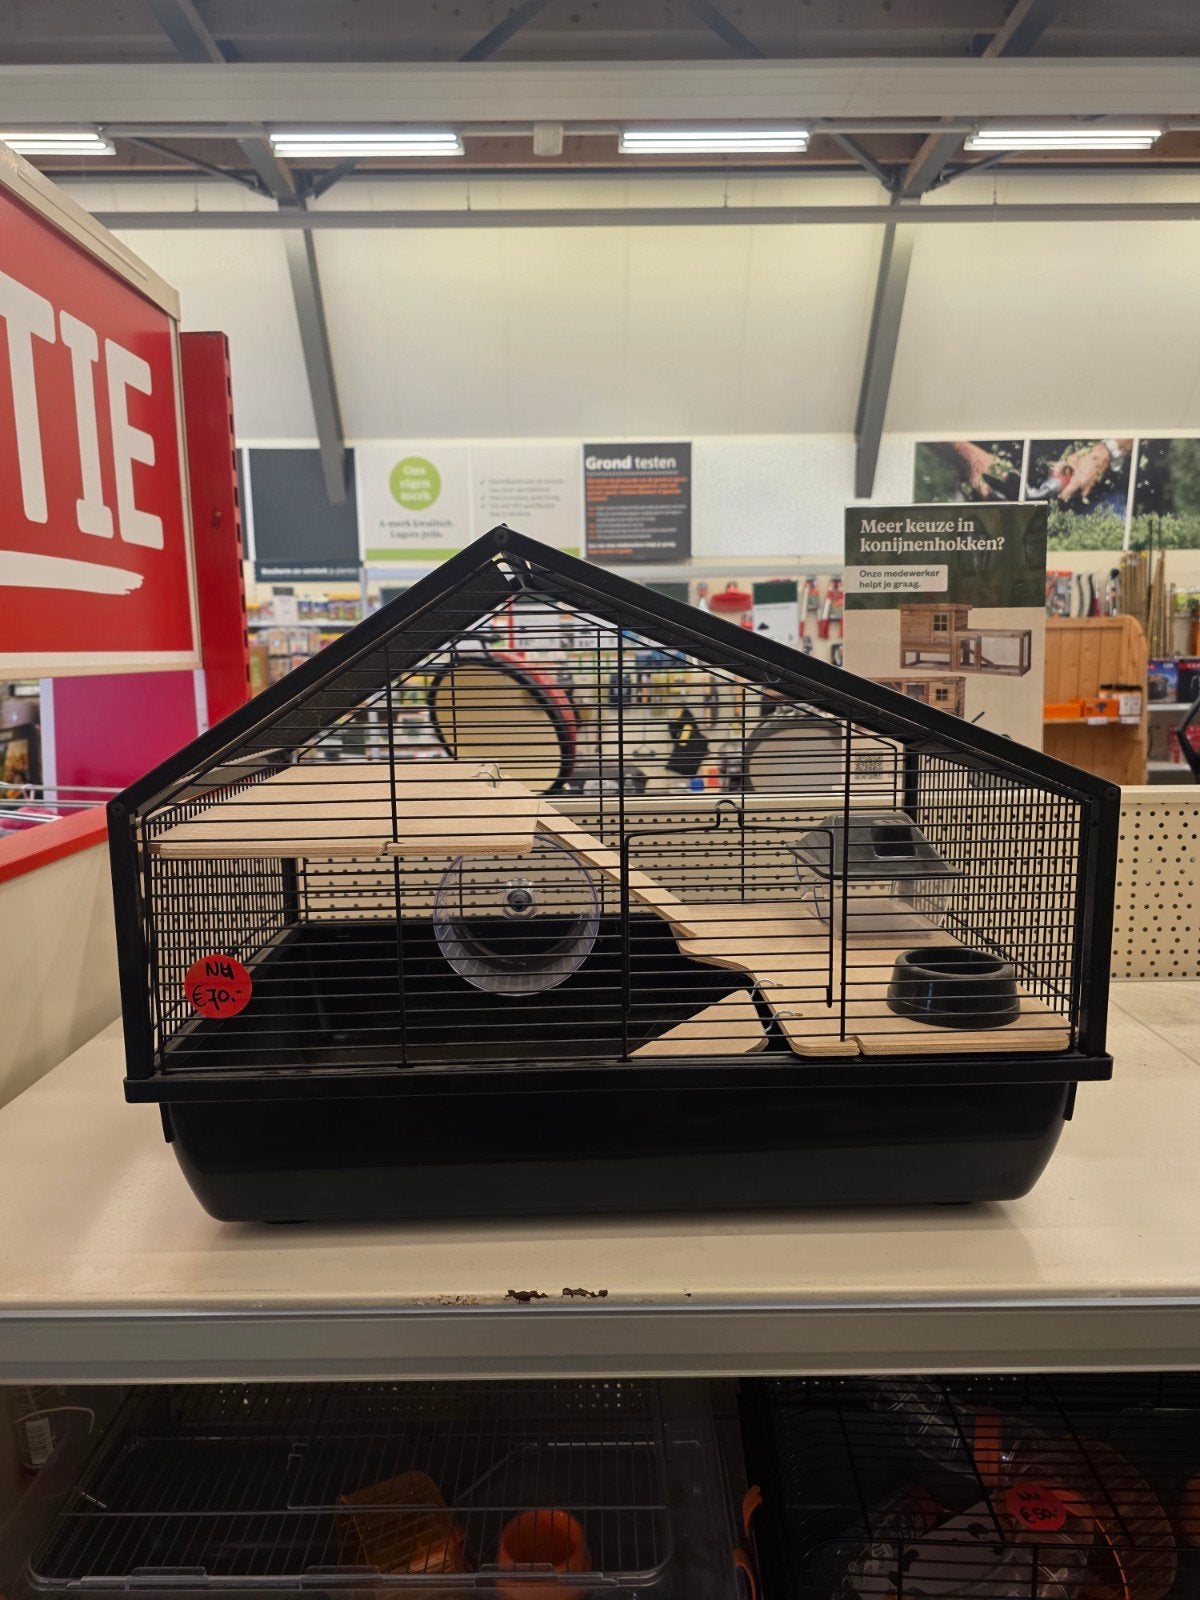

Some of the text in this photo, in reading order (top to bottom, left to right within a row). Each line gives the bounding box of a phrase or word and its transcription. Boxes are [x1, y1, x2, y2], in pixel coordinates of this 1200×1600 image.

[586, 454, 677, 470] Grond testen
[860, 518, 975, 534] Meer keuze in
[860, 537, 1005, 554] konijnenhokken?
[884, 570, 940, 578] medewerker
[859, 580, 922, 590] helpt je graag.
